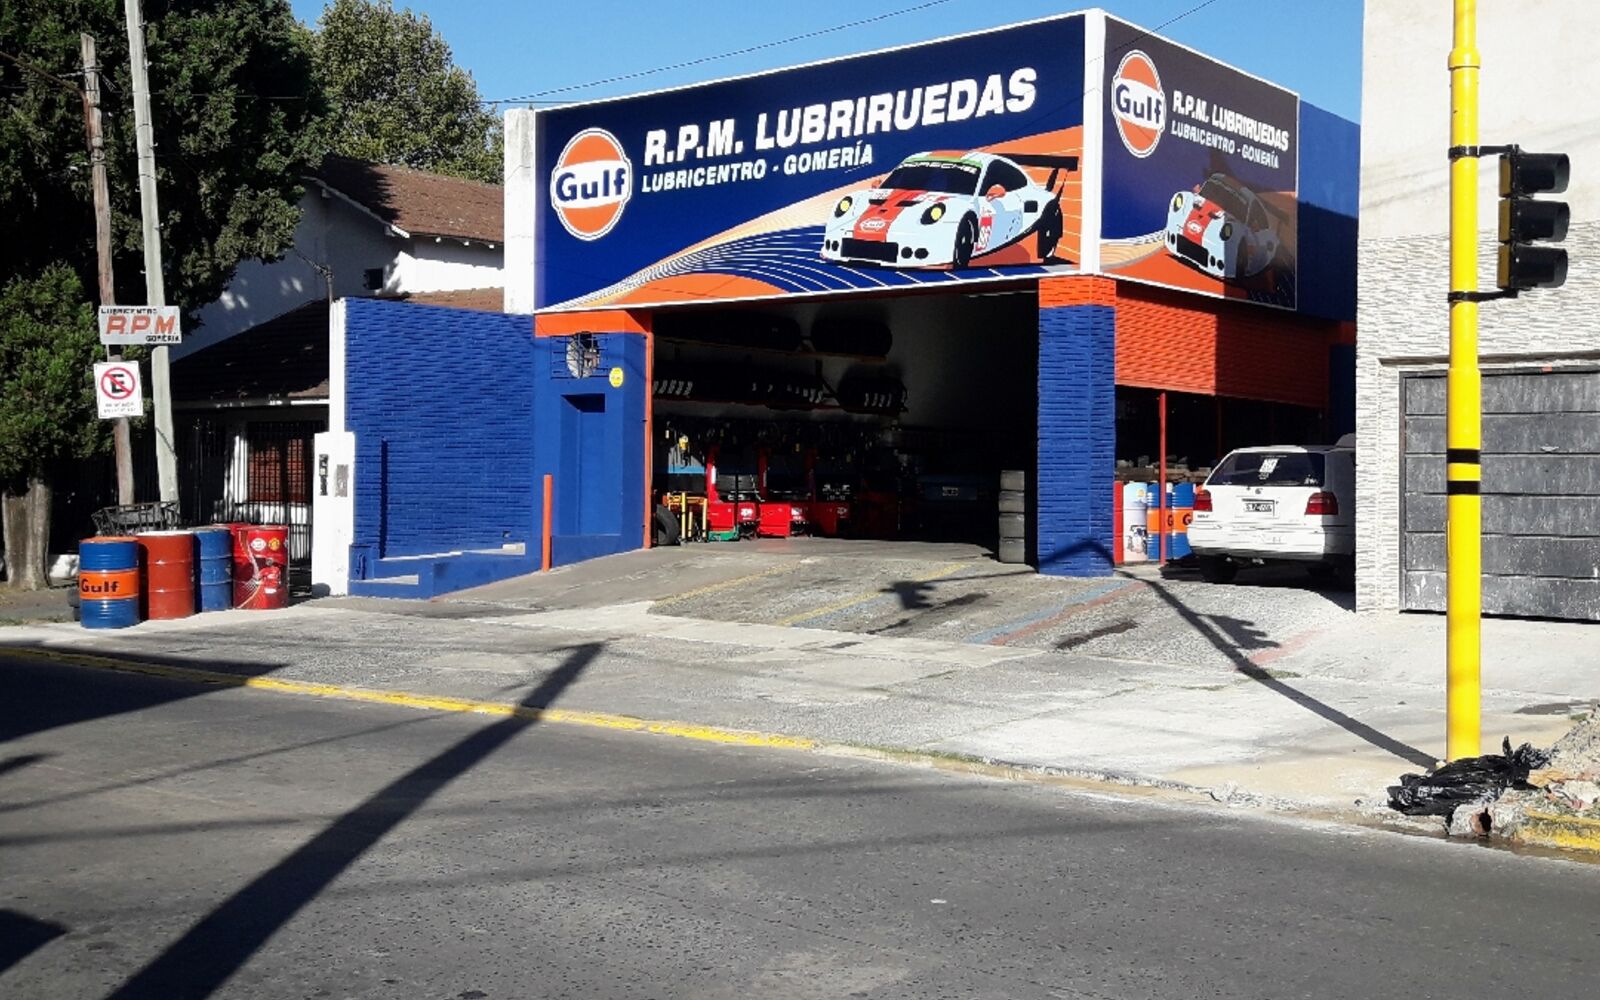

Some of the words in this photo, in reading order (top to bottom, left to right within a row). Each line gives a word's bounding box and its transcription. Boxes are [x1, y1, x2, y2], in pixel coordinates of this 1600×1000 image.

[644, 118, 744, 166] R.P.M.
[755, 67, 1038, 151] LUBRIRUEDAS
[1115, 83, 1162, 125] Gulf
[1172, 90, 1211, 124] R.P.M.
[1211, 103, 1290, 152] LUBRIRUEDAS
[641, 158, 768, 193] LUBRICENTRO
[783, 139, 874, 176] GOMERÍA
[1171, 120, 1236, 155] LUBRICENTRO
[1241, 144, 1280, 169] GOMERÍA
[555, 168, 627, 202] Gulf
[81, 578, 119, 593] Gulf
